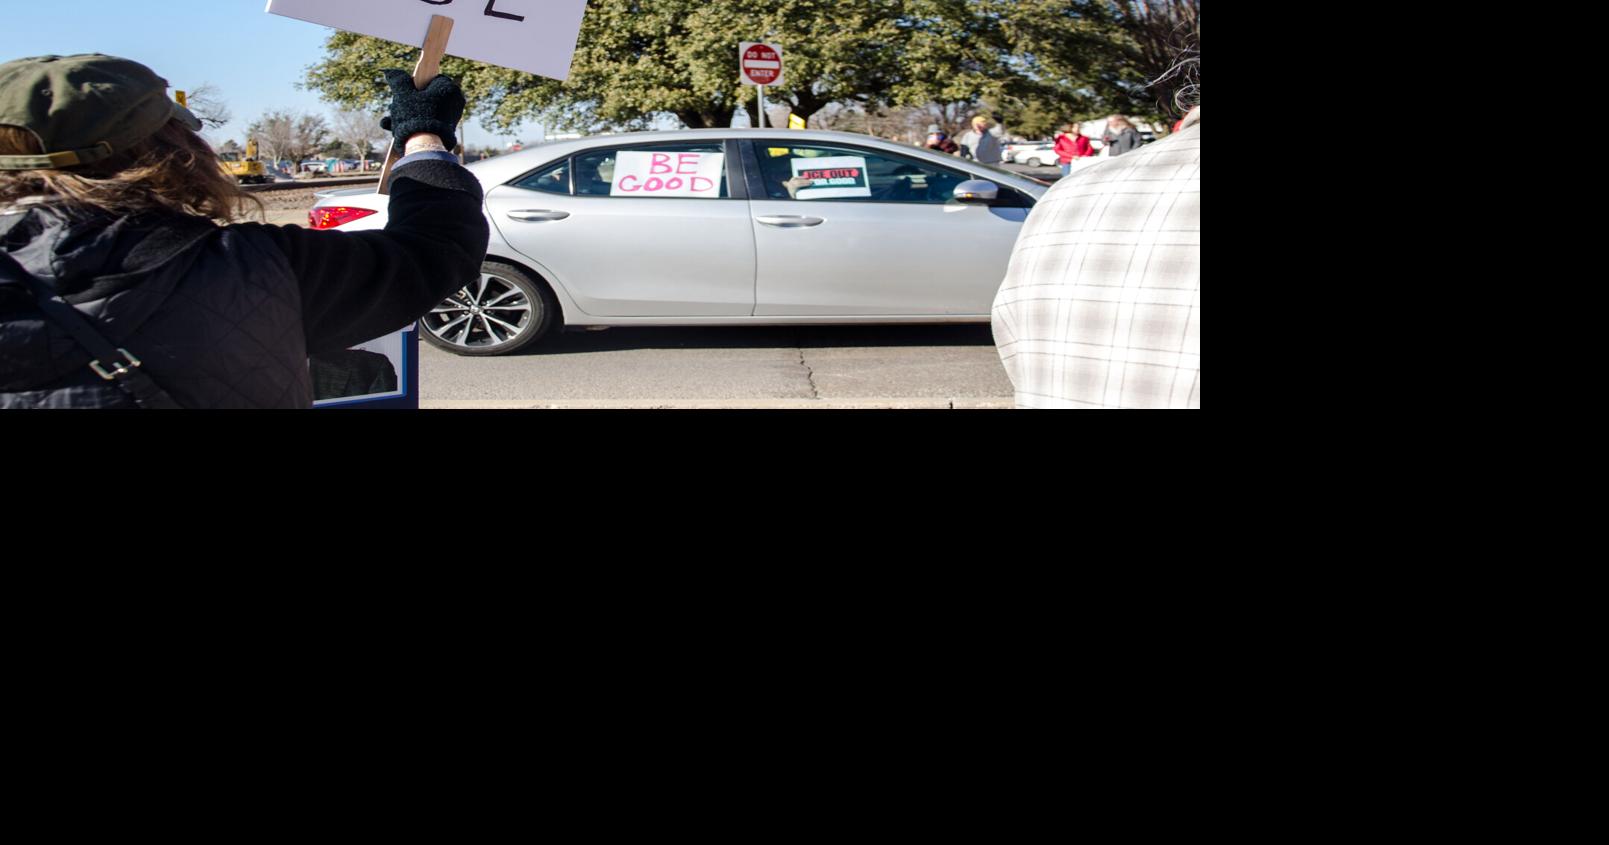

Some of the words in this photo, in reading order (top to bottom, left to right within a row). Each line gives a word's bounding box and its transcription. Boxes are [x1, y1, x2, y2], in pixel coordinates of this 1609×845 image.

[750, 69, 775, 77] ENTER
[649, 153, 700, 174] BE
[830, 168, 853, 178] OUT
[618, 175, 714, 192] GOOD
